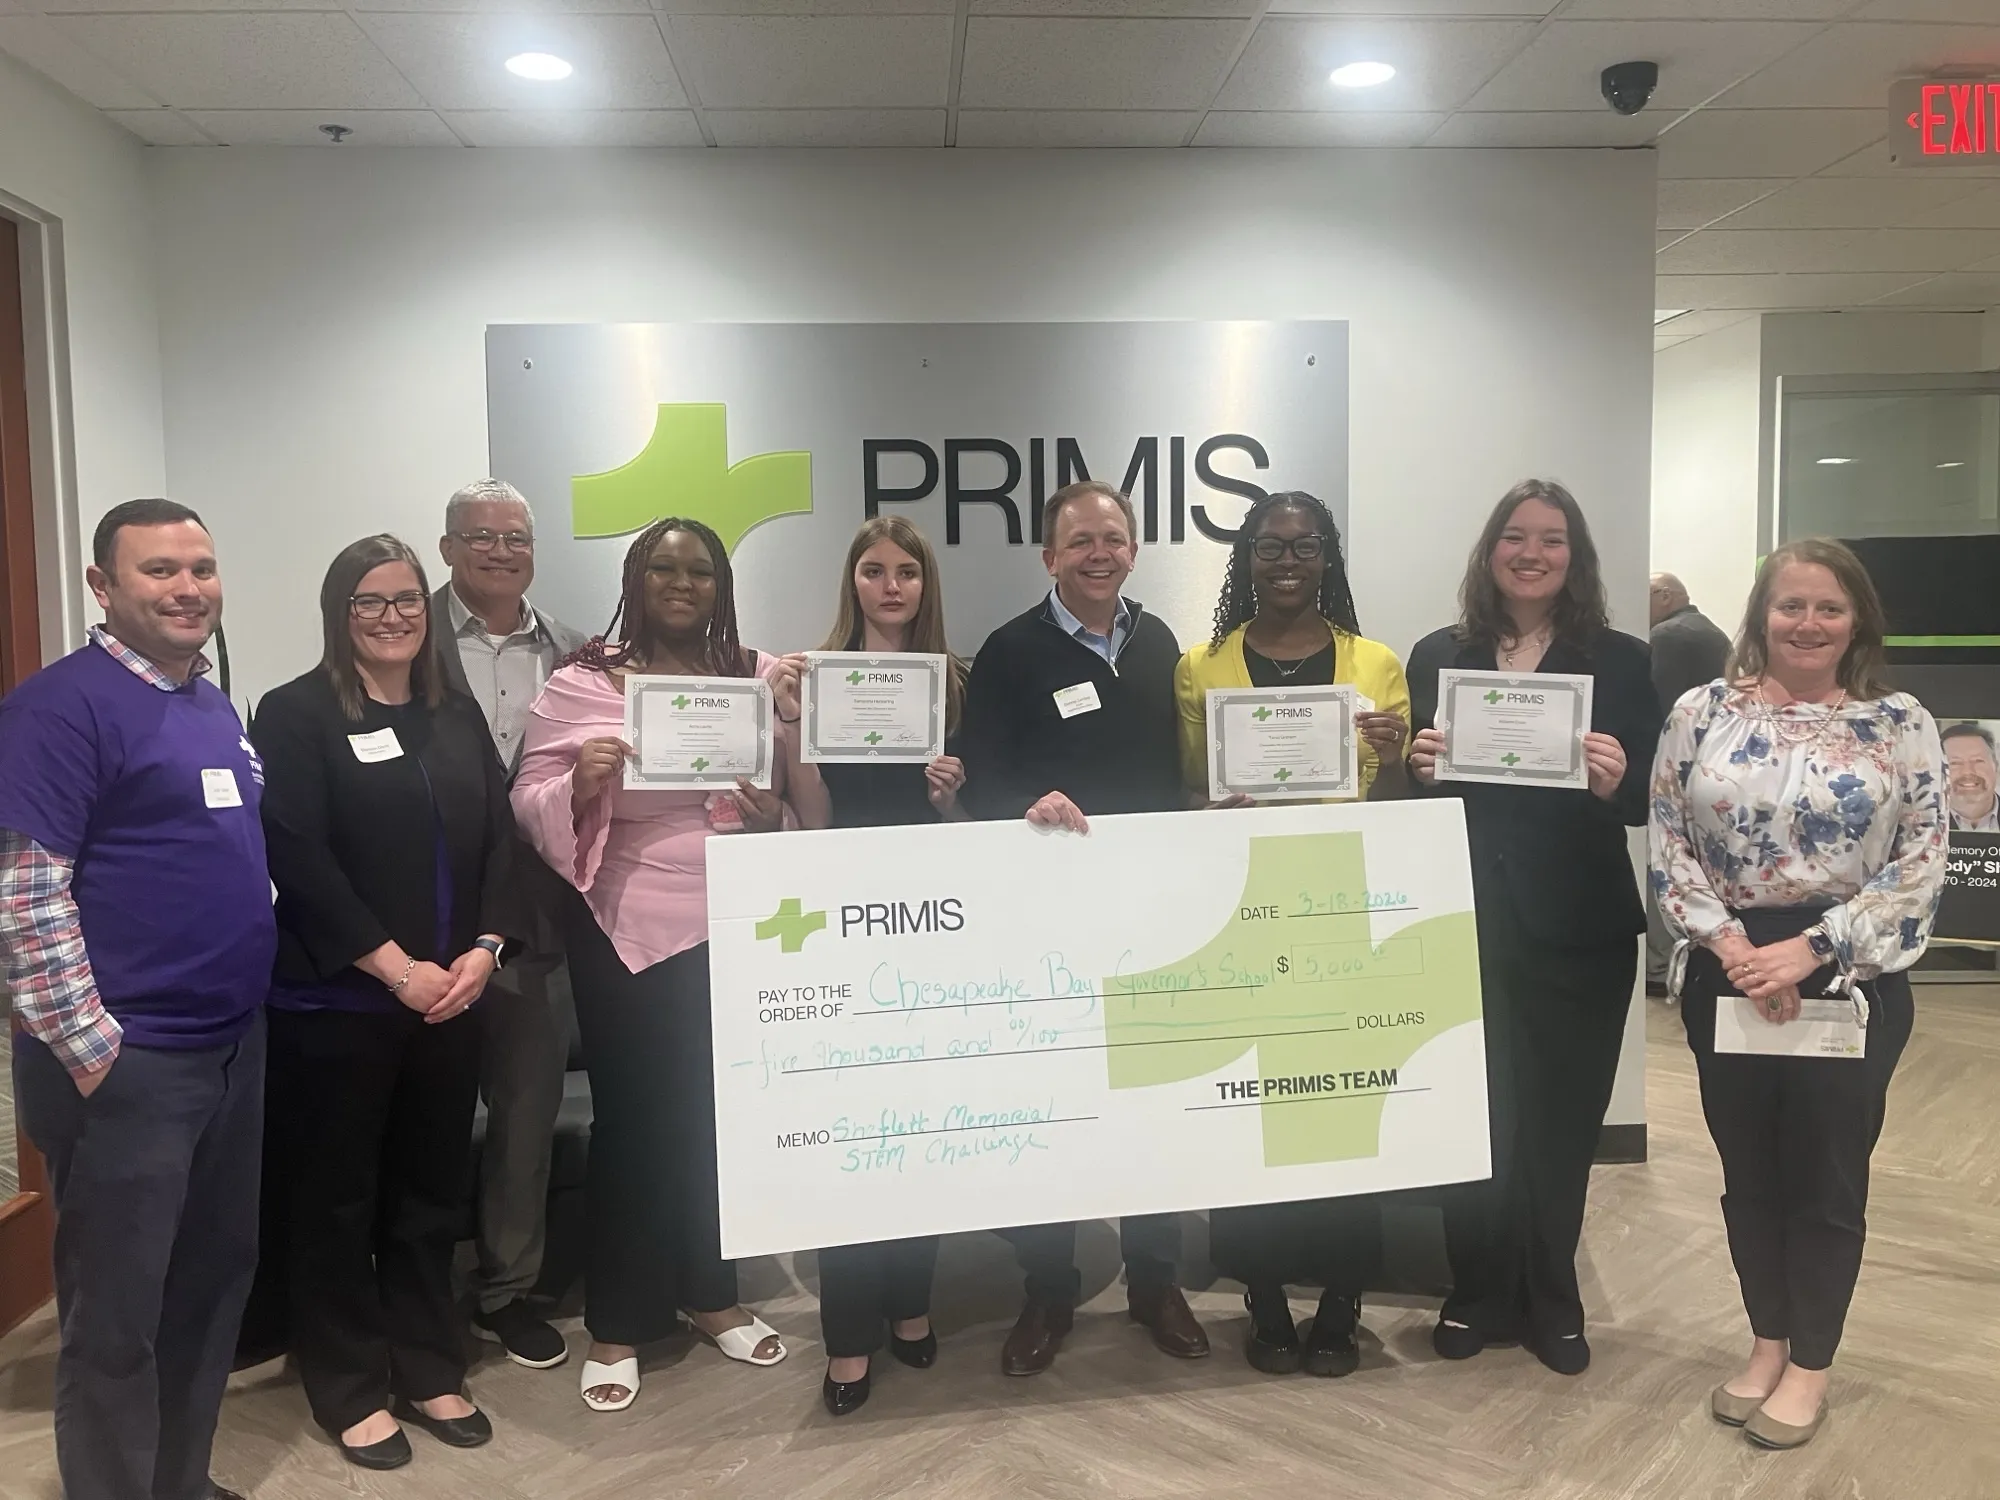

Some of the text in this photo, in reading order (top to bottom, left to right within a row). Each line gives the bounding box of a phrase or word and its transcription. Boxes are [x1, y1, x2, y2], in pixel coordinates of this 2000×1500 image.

[1922, 84, 2000, 154] EXIT
[863, 433, 1269, 545] PRIMIS
[868, 673, 903, 684] PRIMIS
[694, 697, 730, 708] PRIMIS
[1507, 693, 1544, 704] PRIMIS
[1275, 707, 1312, 718] PRIMIS
[1944, 876, 1958, 886] 70
[1967, 877, 1997, 888] 2024
[1240, 905, 1280, 921] DATE
[1298, 891, 1408, 915] 3-18-2026
[841, 898, 965, 938] PRIMIS
[1276, 955, 1290, 974] $
[1306, 956, 1363, 982] 5,000
[758, 983, 852, 1005] PAY TO THE
[870, 961, 1031, 1026] Chesapeake
[1040, 951, 1095, 1019] Bay
[1219, 952, 1276, 997] School
[759, 1003, 844, 1023] ORDER OF
[1356, 1011, 1425, 1030] DOLLARS
[947, 1029, 991, 1056] and
[1216, 1068, 1398, 1100] THE PRIMIS TEAM
[943, 1096, 1054, 1131] Memorial
[777, 1130, 830, 1149] MEMO
[840, 1143, 906, 1173] STEM
